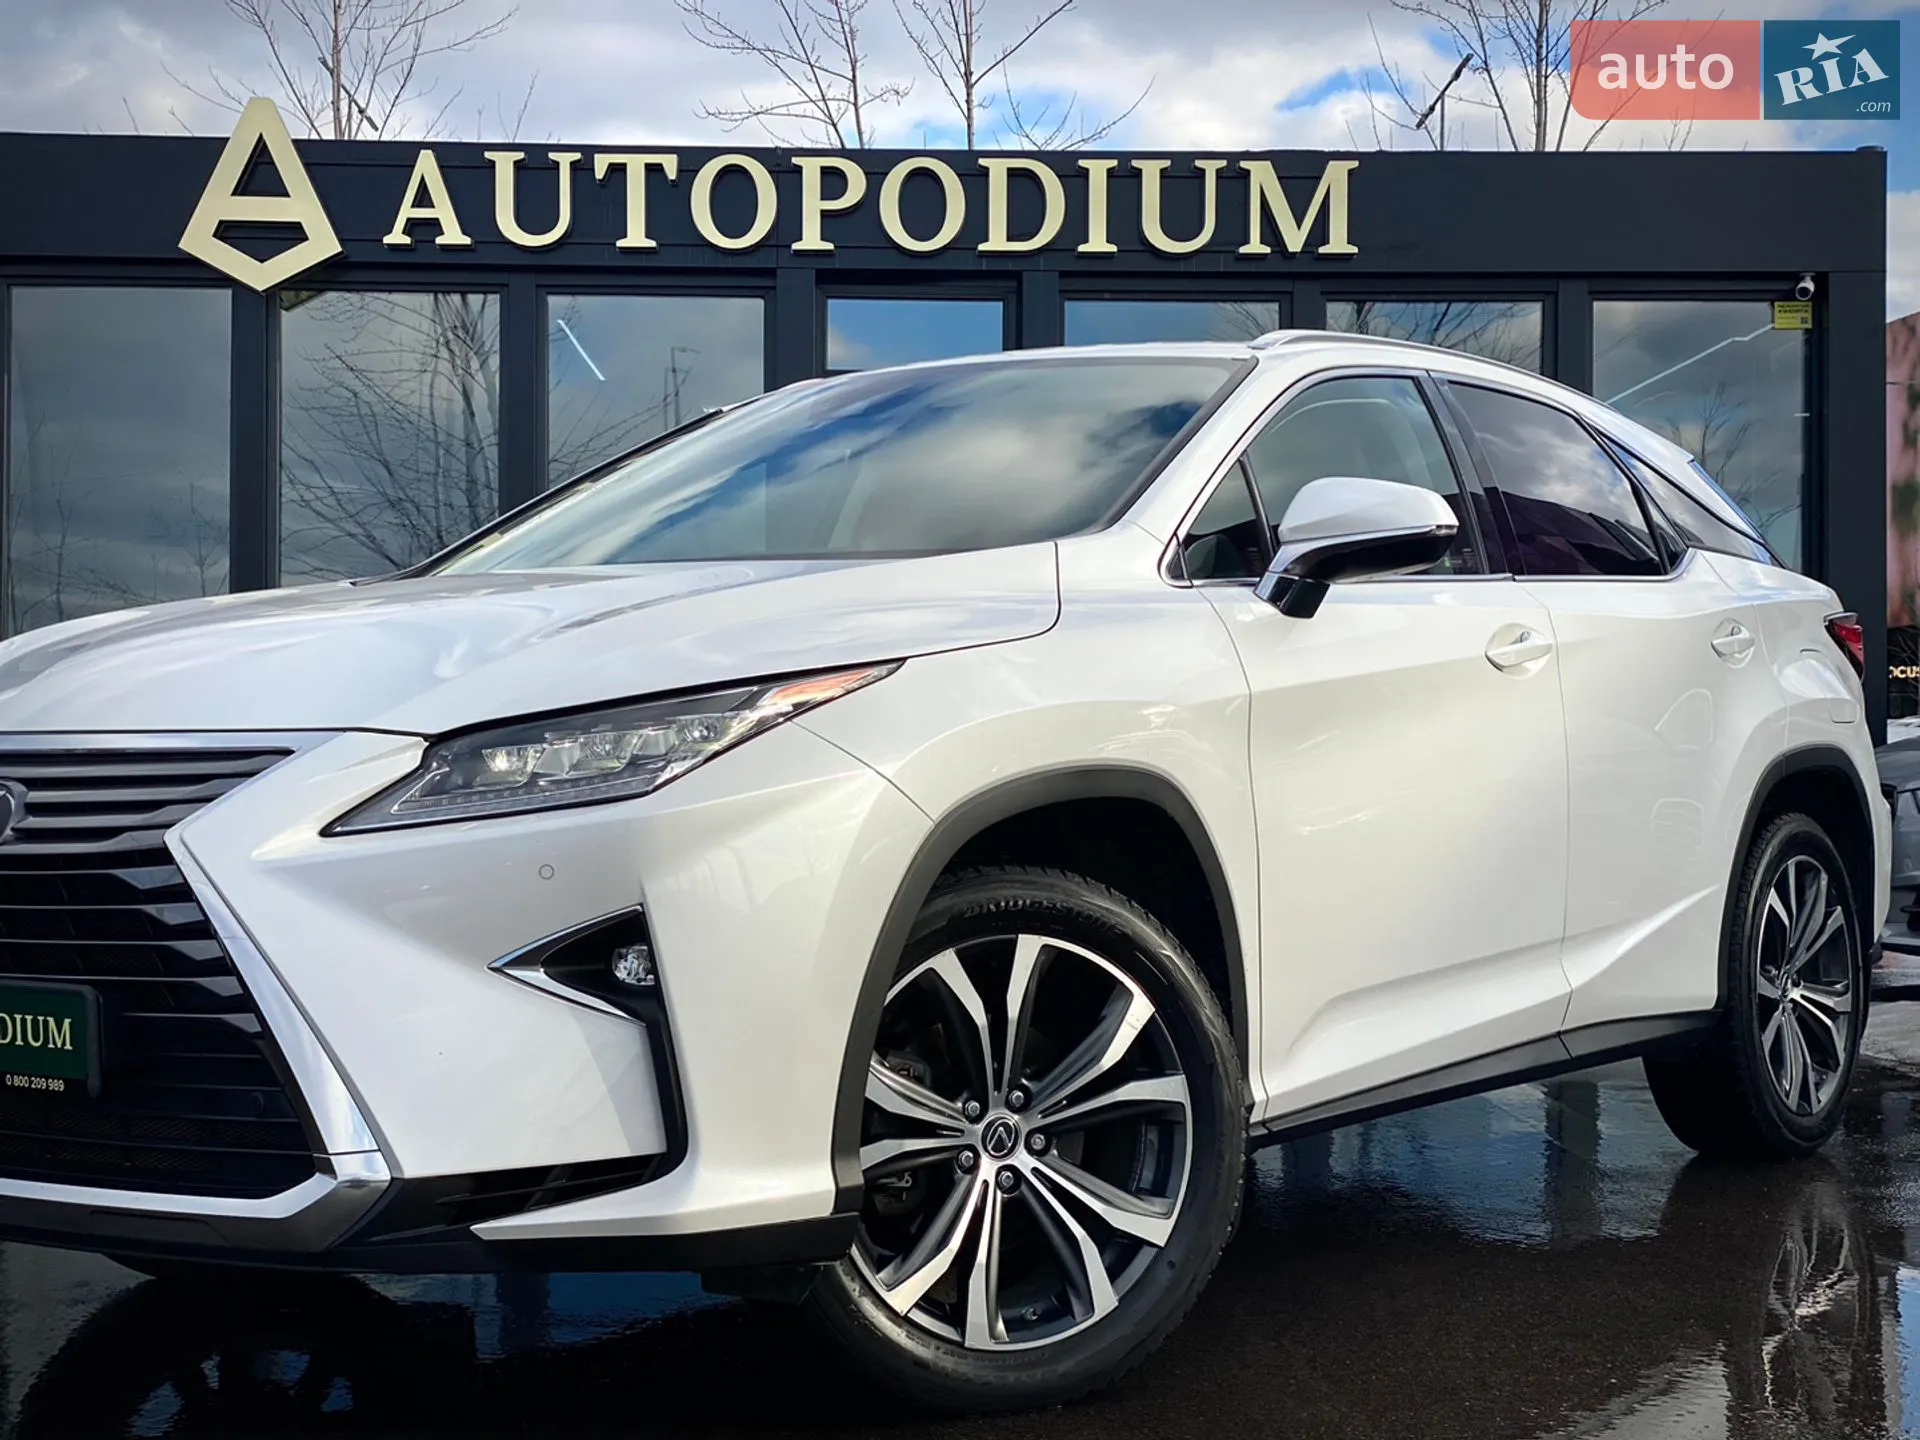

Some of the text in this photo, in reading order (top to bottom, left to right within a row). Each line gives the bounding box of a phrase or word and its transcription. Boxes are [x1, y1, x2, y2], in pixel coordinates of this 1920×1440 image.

[382, 149, 1359, 255] AUTOPODIUM
[5, 1074, 65, 1091] 0 800 209 989
